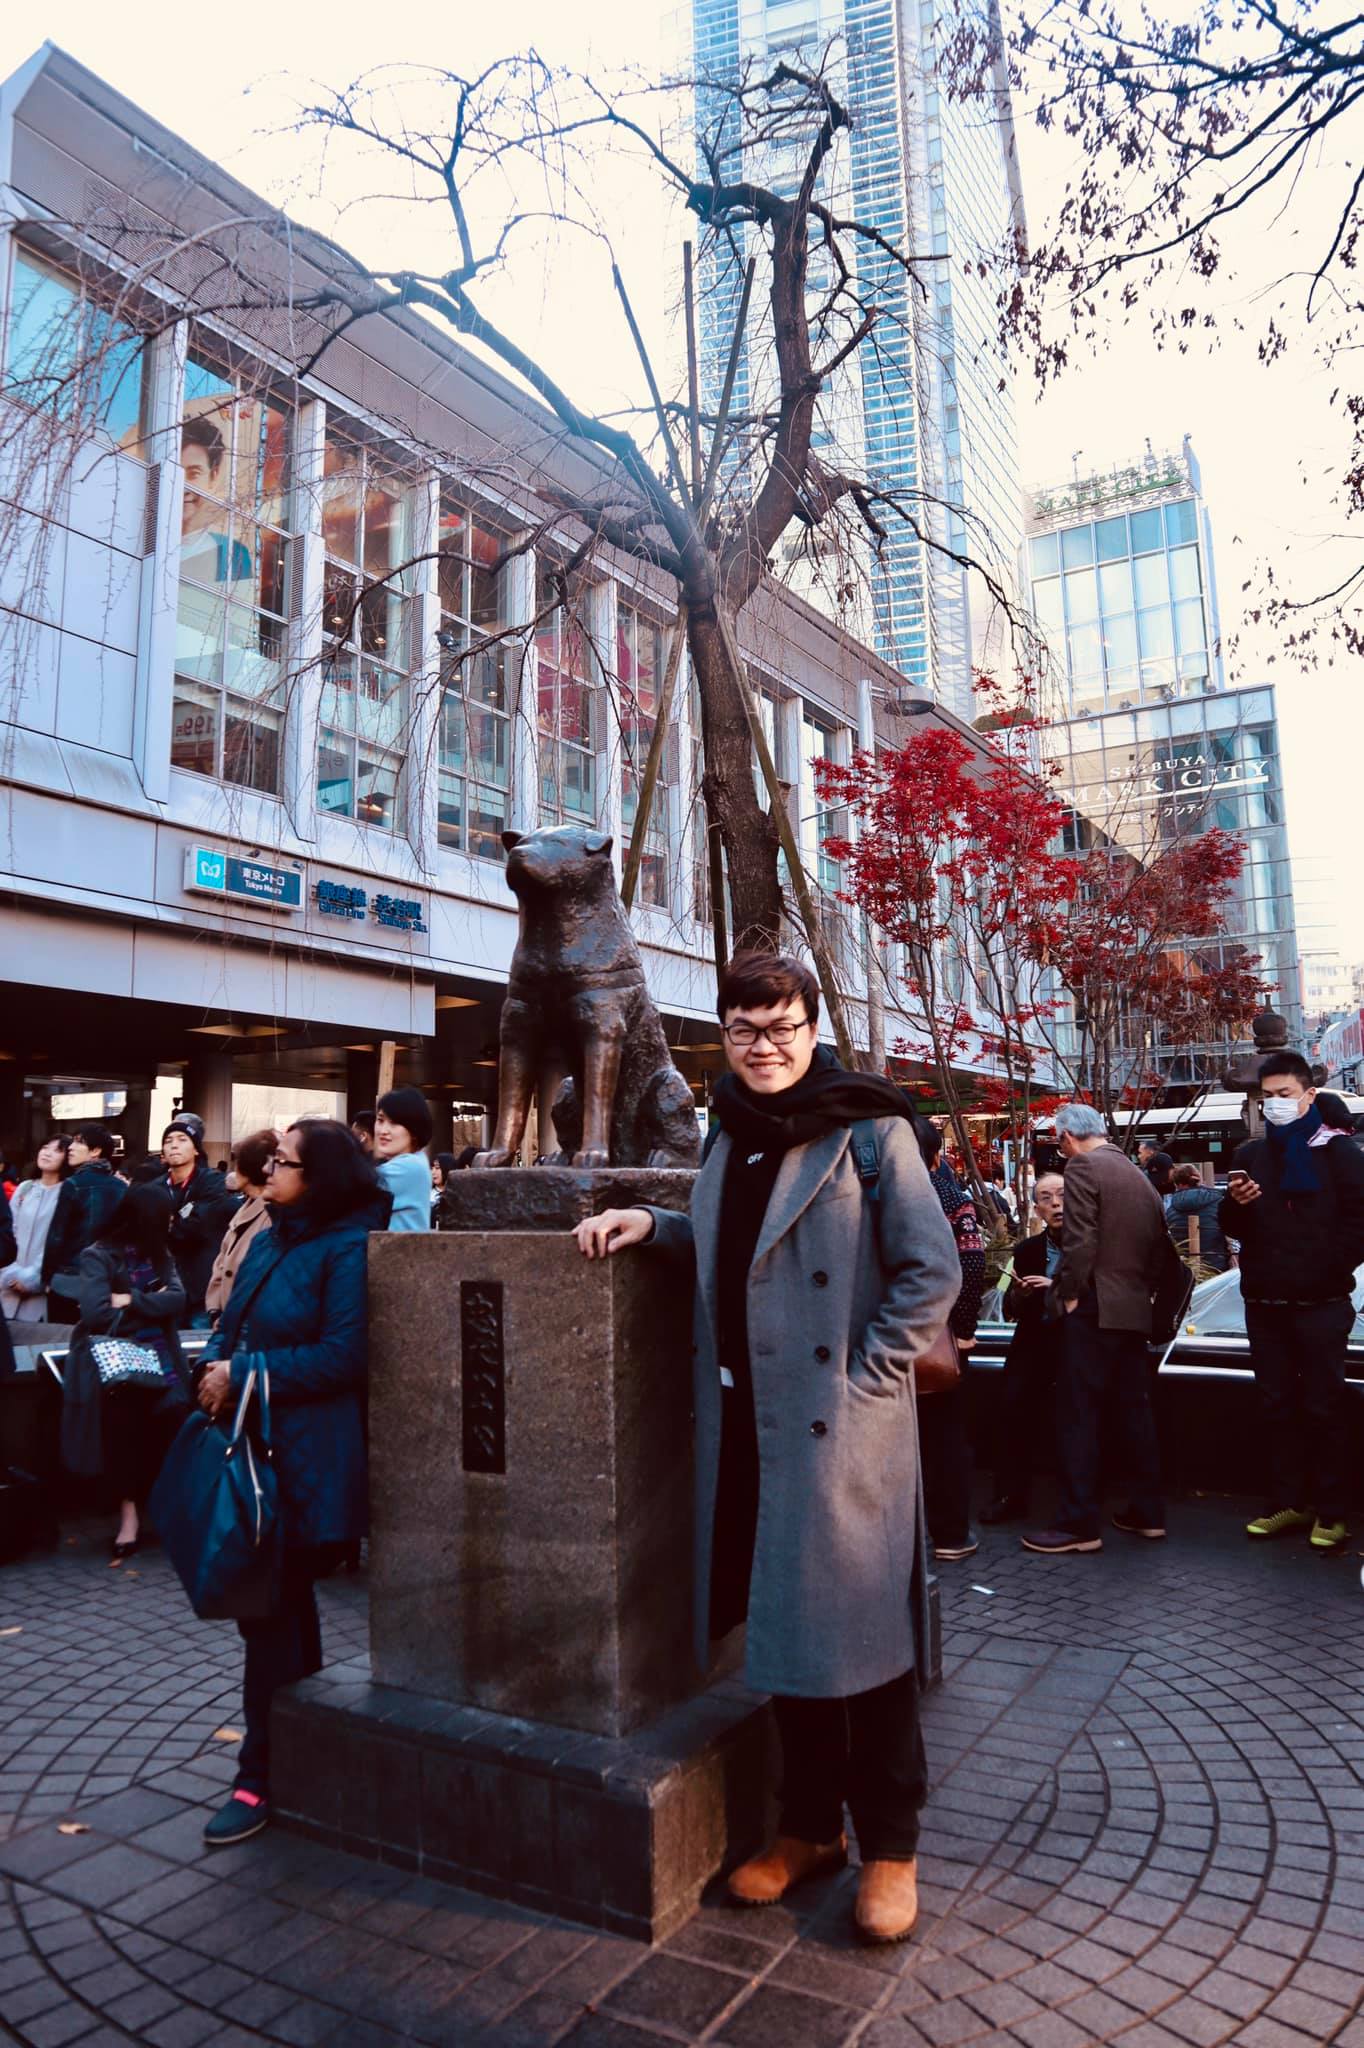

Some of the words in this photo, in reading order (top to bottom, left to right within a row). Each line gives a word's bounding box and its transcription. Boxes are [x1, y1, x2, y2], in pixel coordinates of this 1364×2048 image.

[1109, 755, 1206, 779] SHIBUYA
[1181, 760, 1268, 788] CITY
[243, 867, 285, 887] 東京メトロ
[245, 880, 263, 891] Tokyo
[264, 883, 282, 895] Metro
[319, 902, 345, 916] Ginza
[378, 912, 411, 930] Shibuya
[413, 920, 428, 933] Sta.
[376, 894, 421, 920] 渋谷駅
[747, 1152, 764, 1164] OFF
